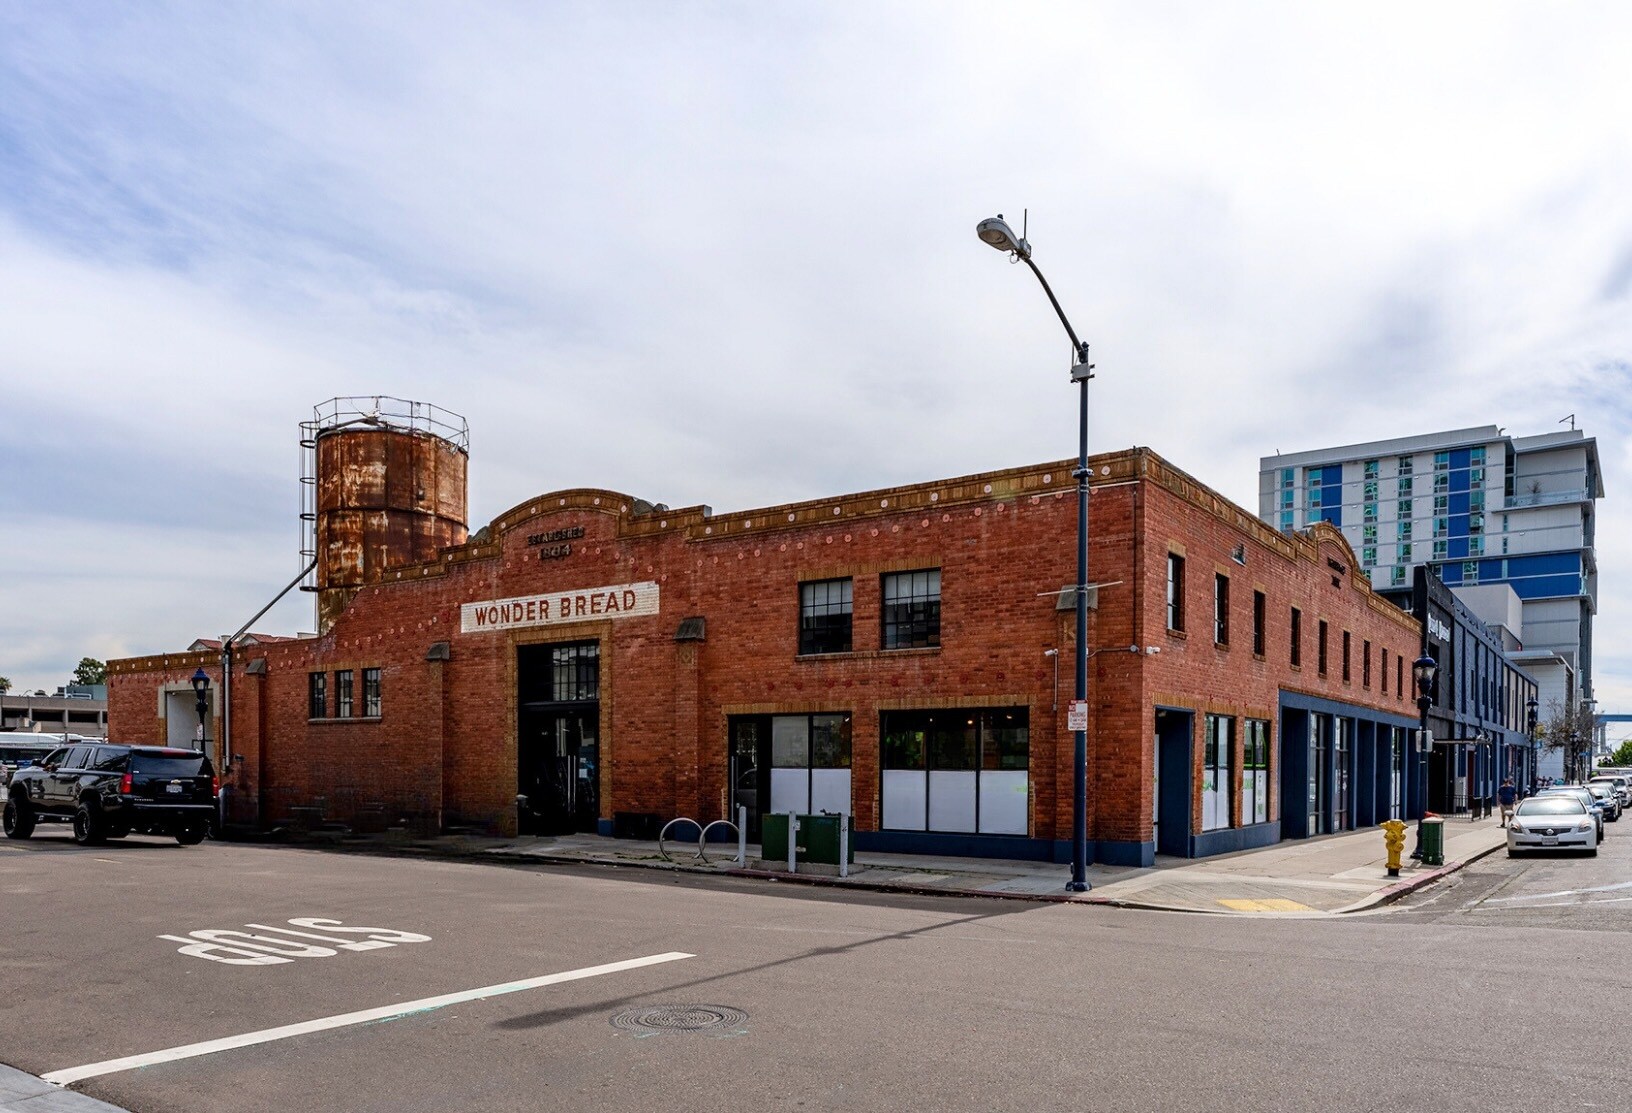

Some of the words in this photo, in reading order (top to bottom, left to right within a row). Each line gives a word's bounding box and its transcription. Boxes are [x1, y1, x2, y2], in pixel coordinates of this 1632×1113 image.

[475, 600, 550, 626] WONDER
[560, 589, 636, 618] BREAD
[156, 917, 432, 966] STOP
